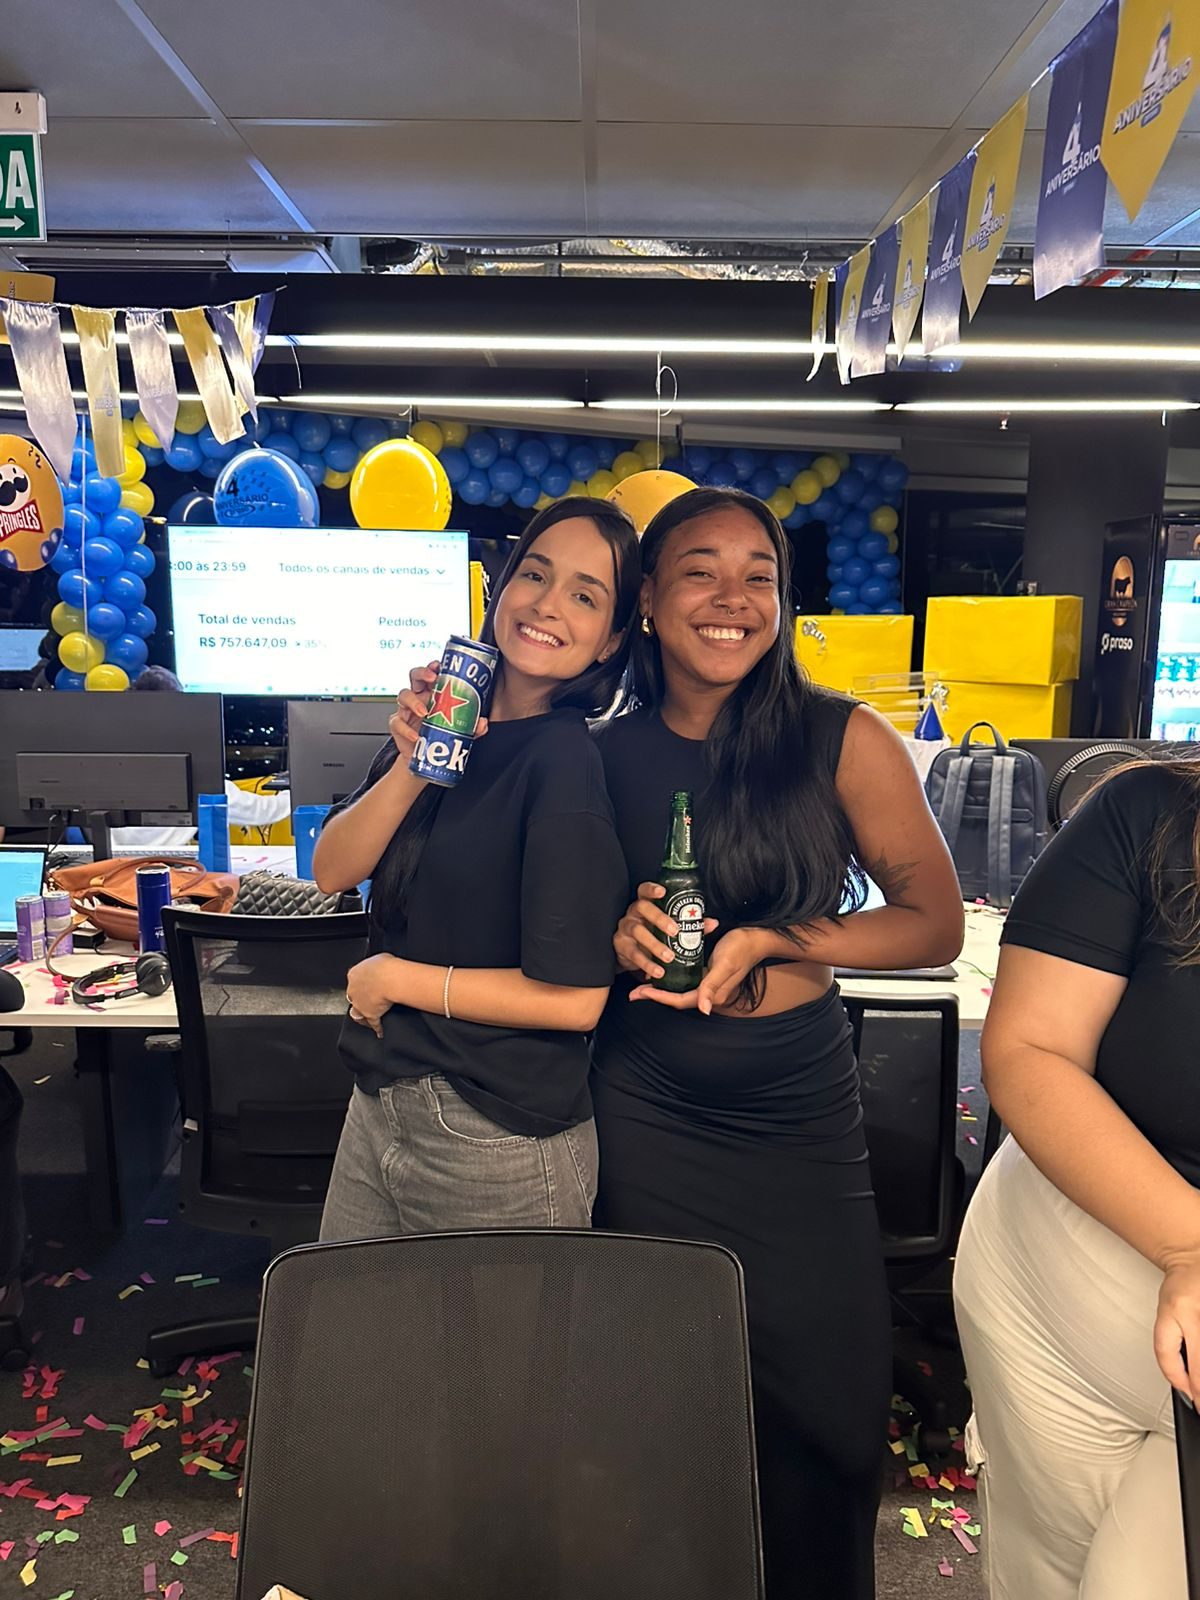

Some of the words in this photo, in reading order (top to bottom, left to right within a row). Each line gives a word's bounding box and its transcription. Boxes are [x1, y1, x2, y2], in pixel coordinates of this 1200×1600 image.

[1143, 36, 1169, 92] 4
[1112, 57, 1192, 135] ANIVERSÁRIO
[1062, 122, 1081, 166] 4
[0, 149, 35, 209] A
[1045, 144, 1101, 198] ANIVERSÁRIO
[980, 192, 995, 227] 4
[942, 233, 955, 262] 4
[872, 283, 884, 306] 4
[226, 477, 239, 498] 4
[0, 503, 41, 538] PRINGLES
[213, 561, 246, 571] 23:59
[279, 562, 313, 573] Todos
[316, 564, 330, 573] os
[333, 564, 369, 574] canais
[372, 564, 386, 574] de
[390, 565, 430, 576] vendas
[198, 613, 229, 624] Total
[232, 614, 248, 625] de
[251, 615, 297, 625] vendas
[379, 616, 427, 627] Pedidos
[199, 637, 216, 647] R$
[219, 637, 287, 649] 757.647,09
[379, 639, 402, 649] 967
[1110, 636, 1133, 652] praso
[466, 662, 489, 688] 0.0
[412, 736, 469, 773] nek
